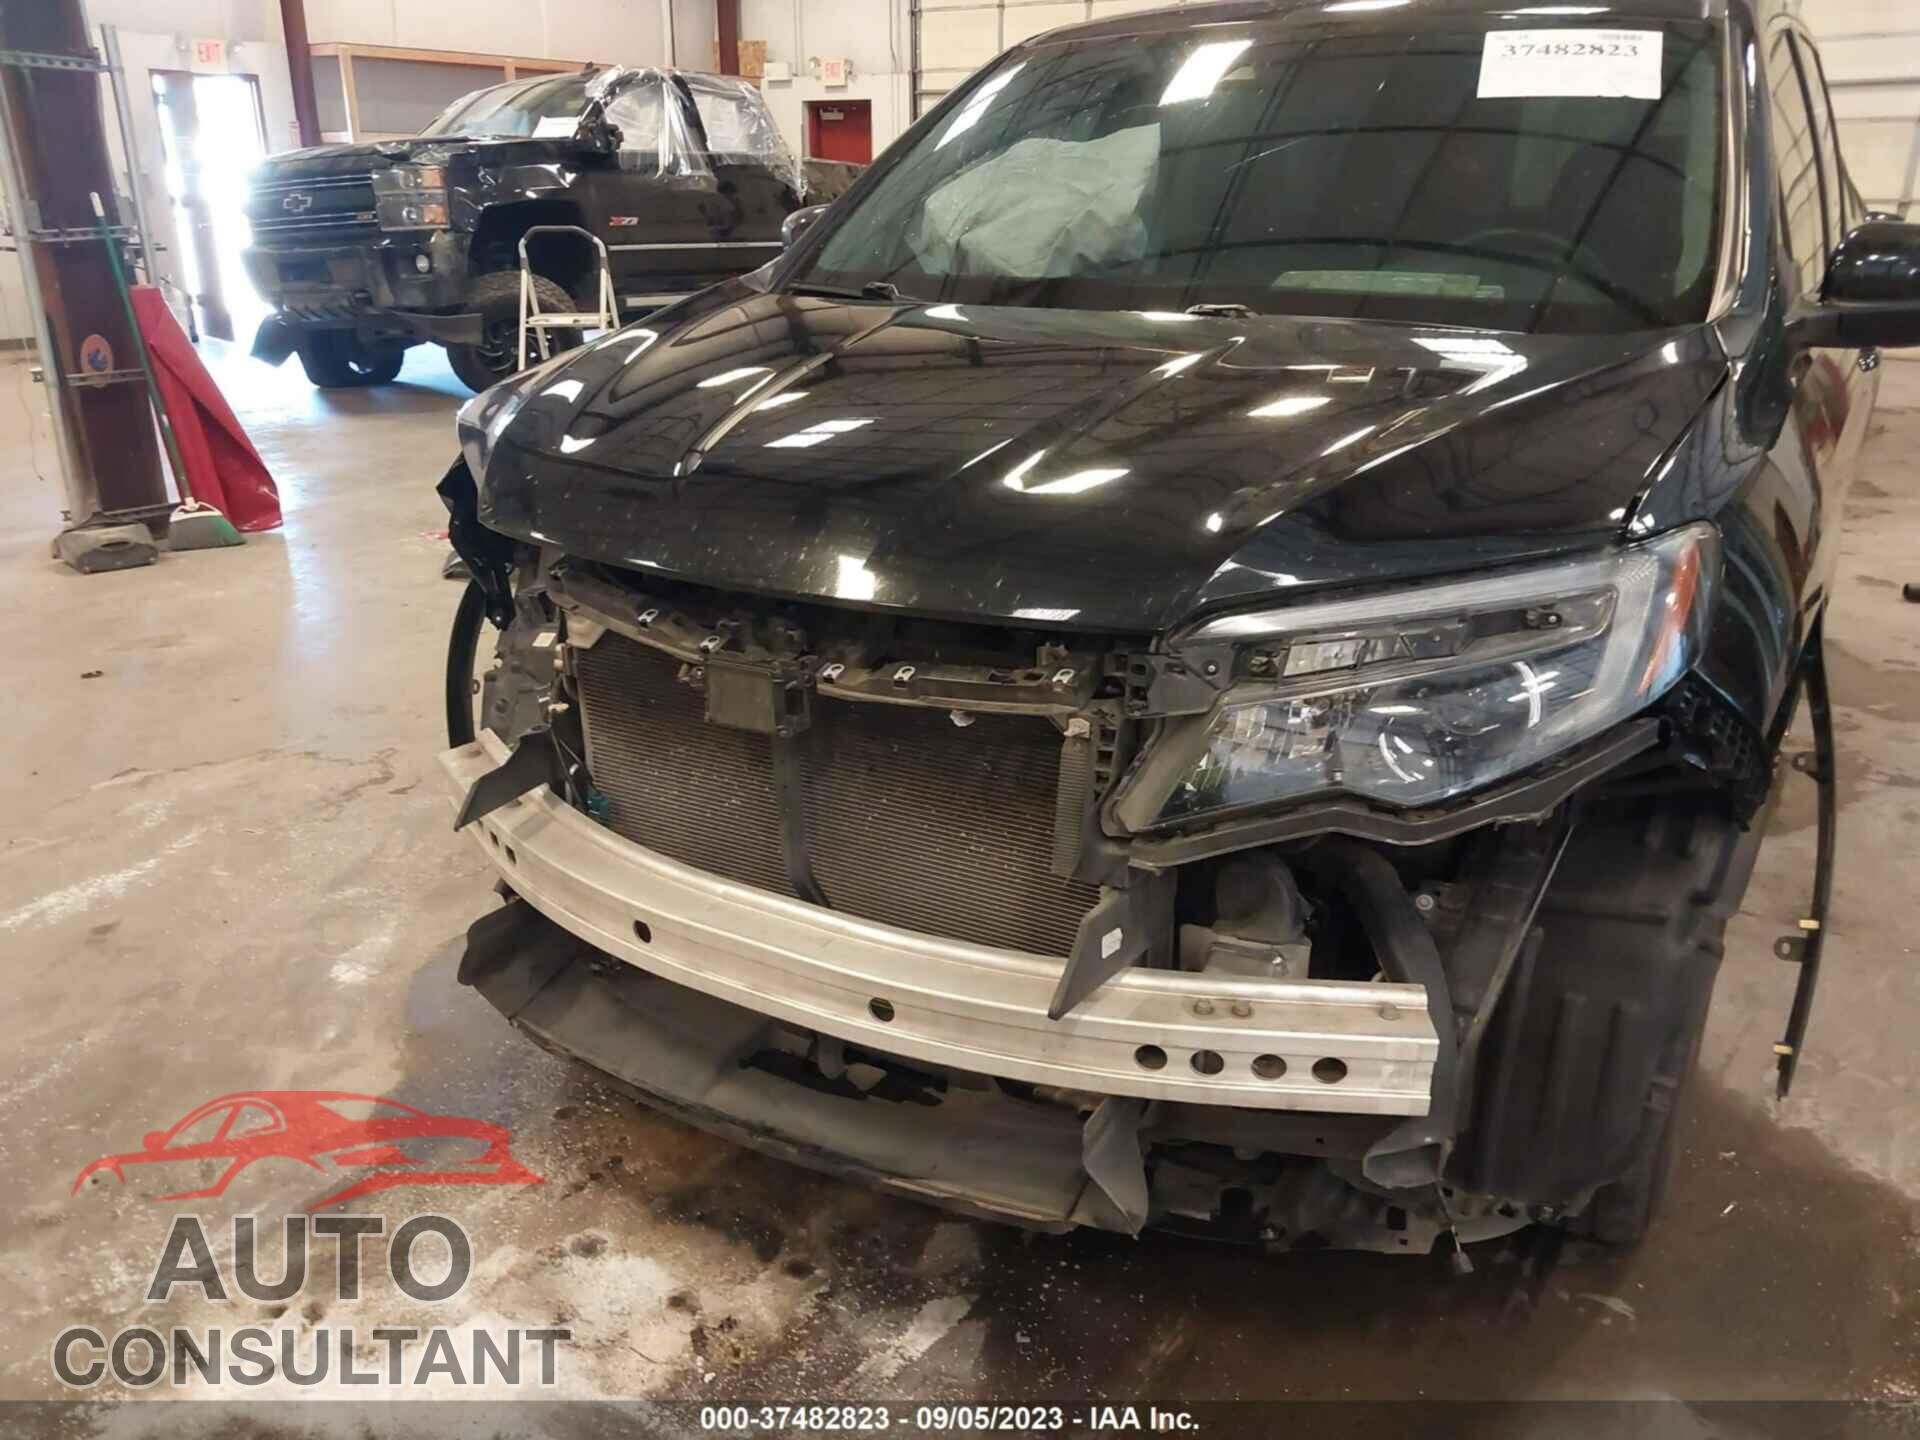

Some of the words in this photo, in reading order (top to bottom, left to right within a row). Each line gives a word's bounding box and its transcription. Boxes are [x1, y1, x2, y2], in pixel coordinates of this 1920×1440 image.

[197, 42, 220, 64] EXIT
[1501, 43, 1639, 56] 37482823
[825, 62, 842, 79] EXIT
